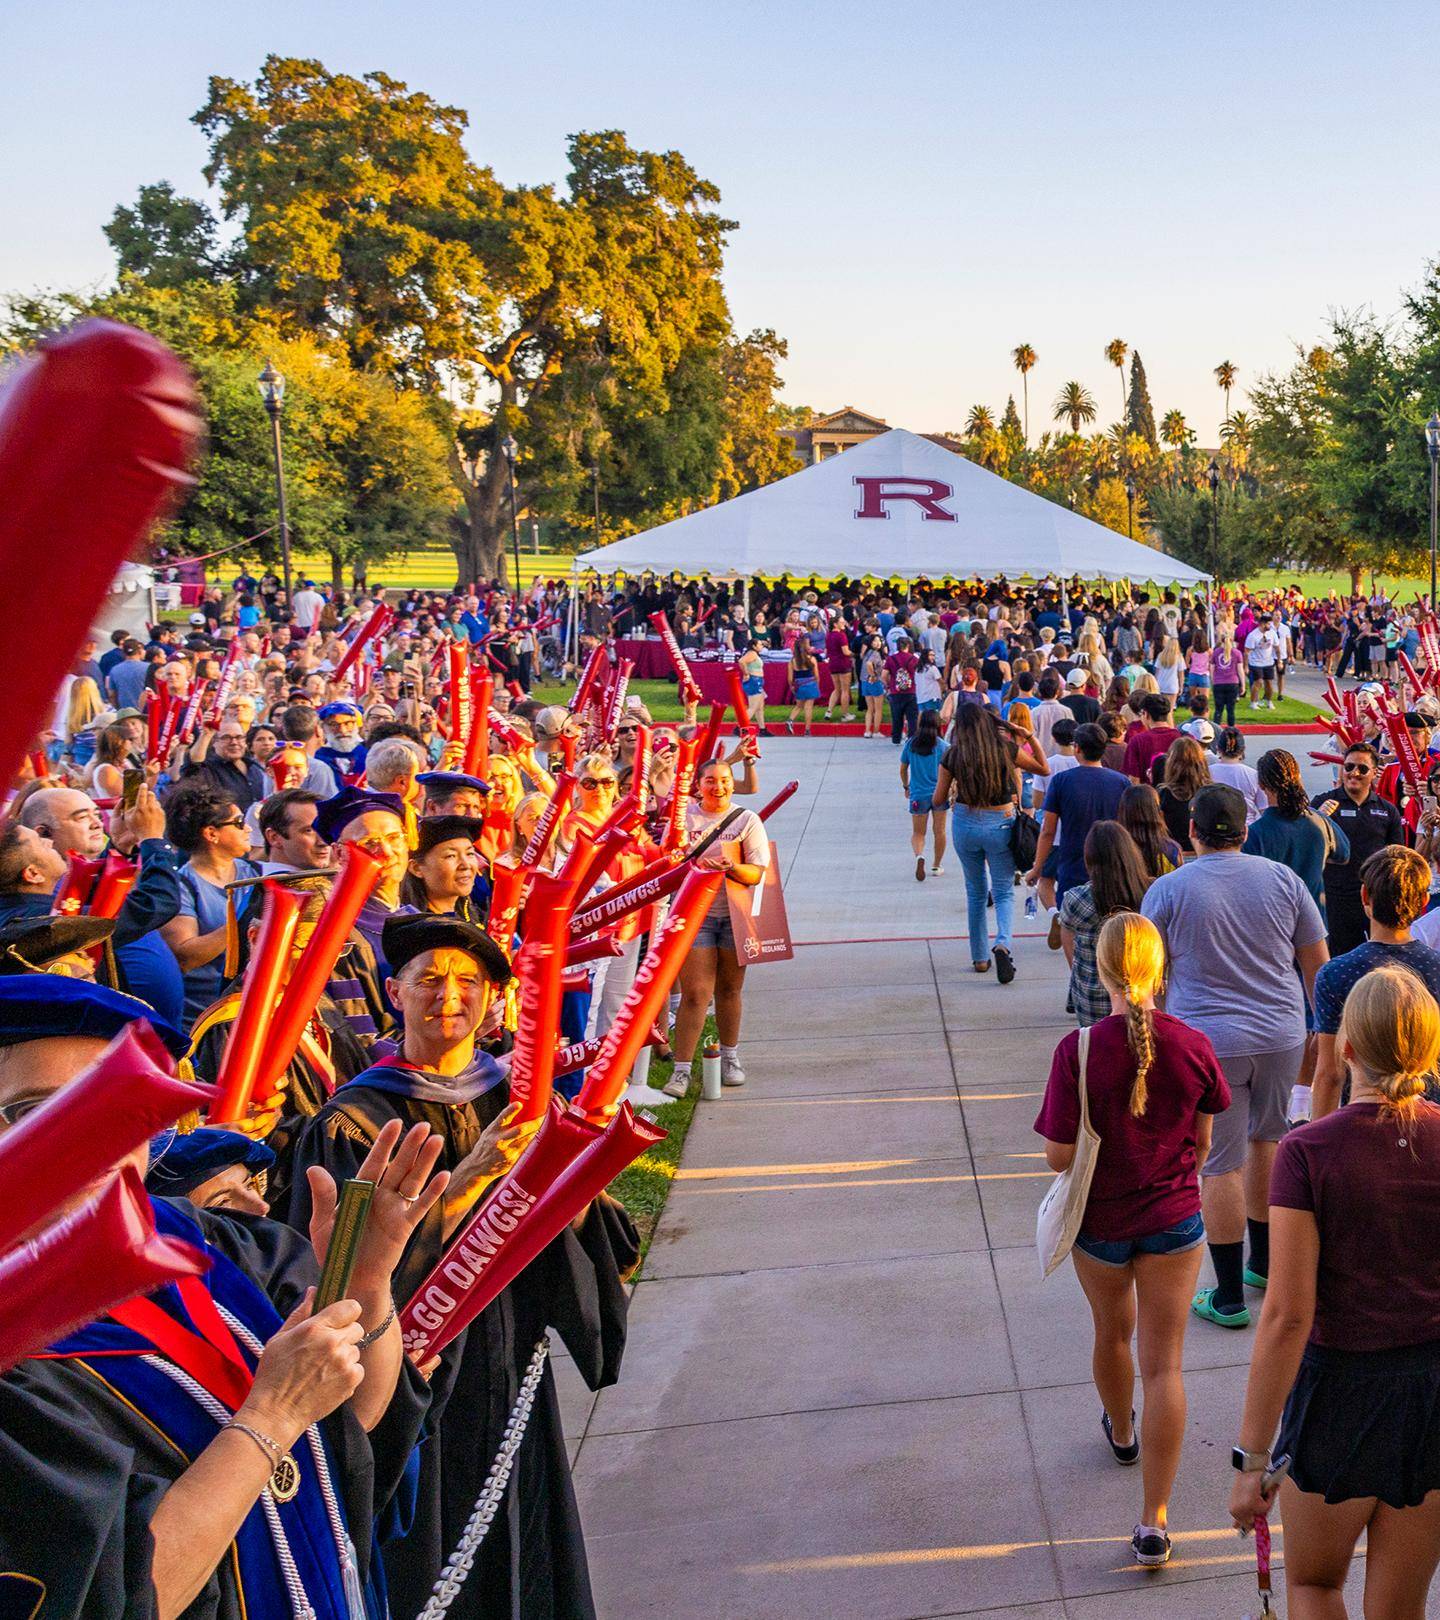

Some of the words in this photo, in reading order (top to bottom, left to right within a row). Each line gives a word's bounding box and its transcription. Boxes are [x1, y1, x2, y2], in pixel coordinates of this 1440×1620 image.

[851, 475, 960, 523] R
[614, 676, 632, 706] DAWGS!
[1398, 733, 1416, 761] DAWGS!
[522, 846, 538, 865] GO
[581, 908, 603, 927] GO
[605, 878, 662, 915] DAWGS!
[636, 952, 662, 984] GO
[519, 980, 541, 1010] GO
[589, 989, 644, 1080] DAWGS!
[510, 1020, 537, 1101] DAWGS!
[411, 1285, 457, 1330] GO
[443, 1178, 537, 1290] DAWGS!
